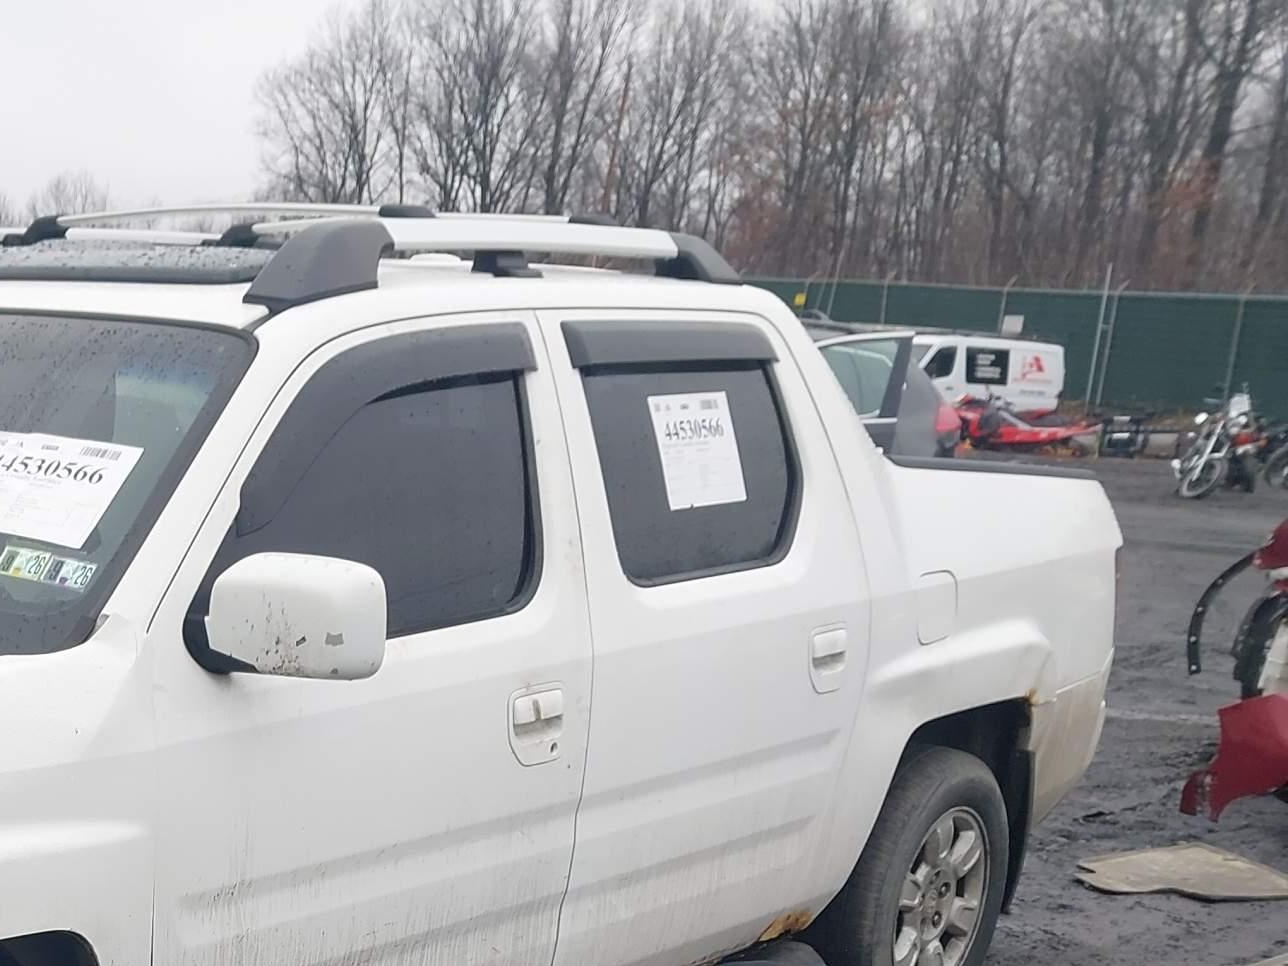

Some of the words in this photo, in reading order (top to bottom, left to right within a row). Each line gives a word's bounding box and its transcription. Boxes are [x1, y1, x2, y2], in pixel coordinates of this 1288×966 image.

[664, 417, 725, 440] 44530566
[28, 555, 46, 575] 26
[74, 565, 94, 586] 26
